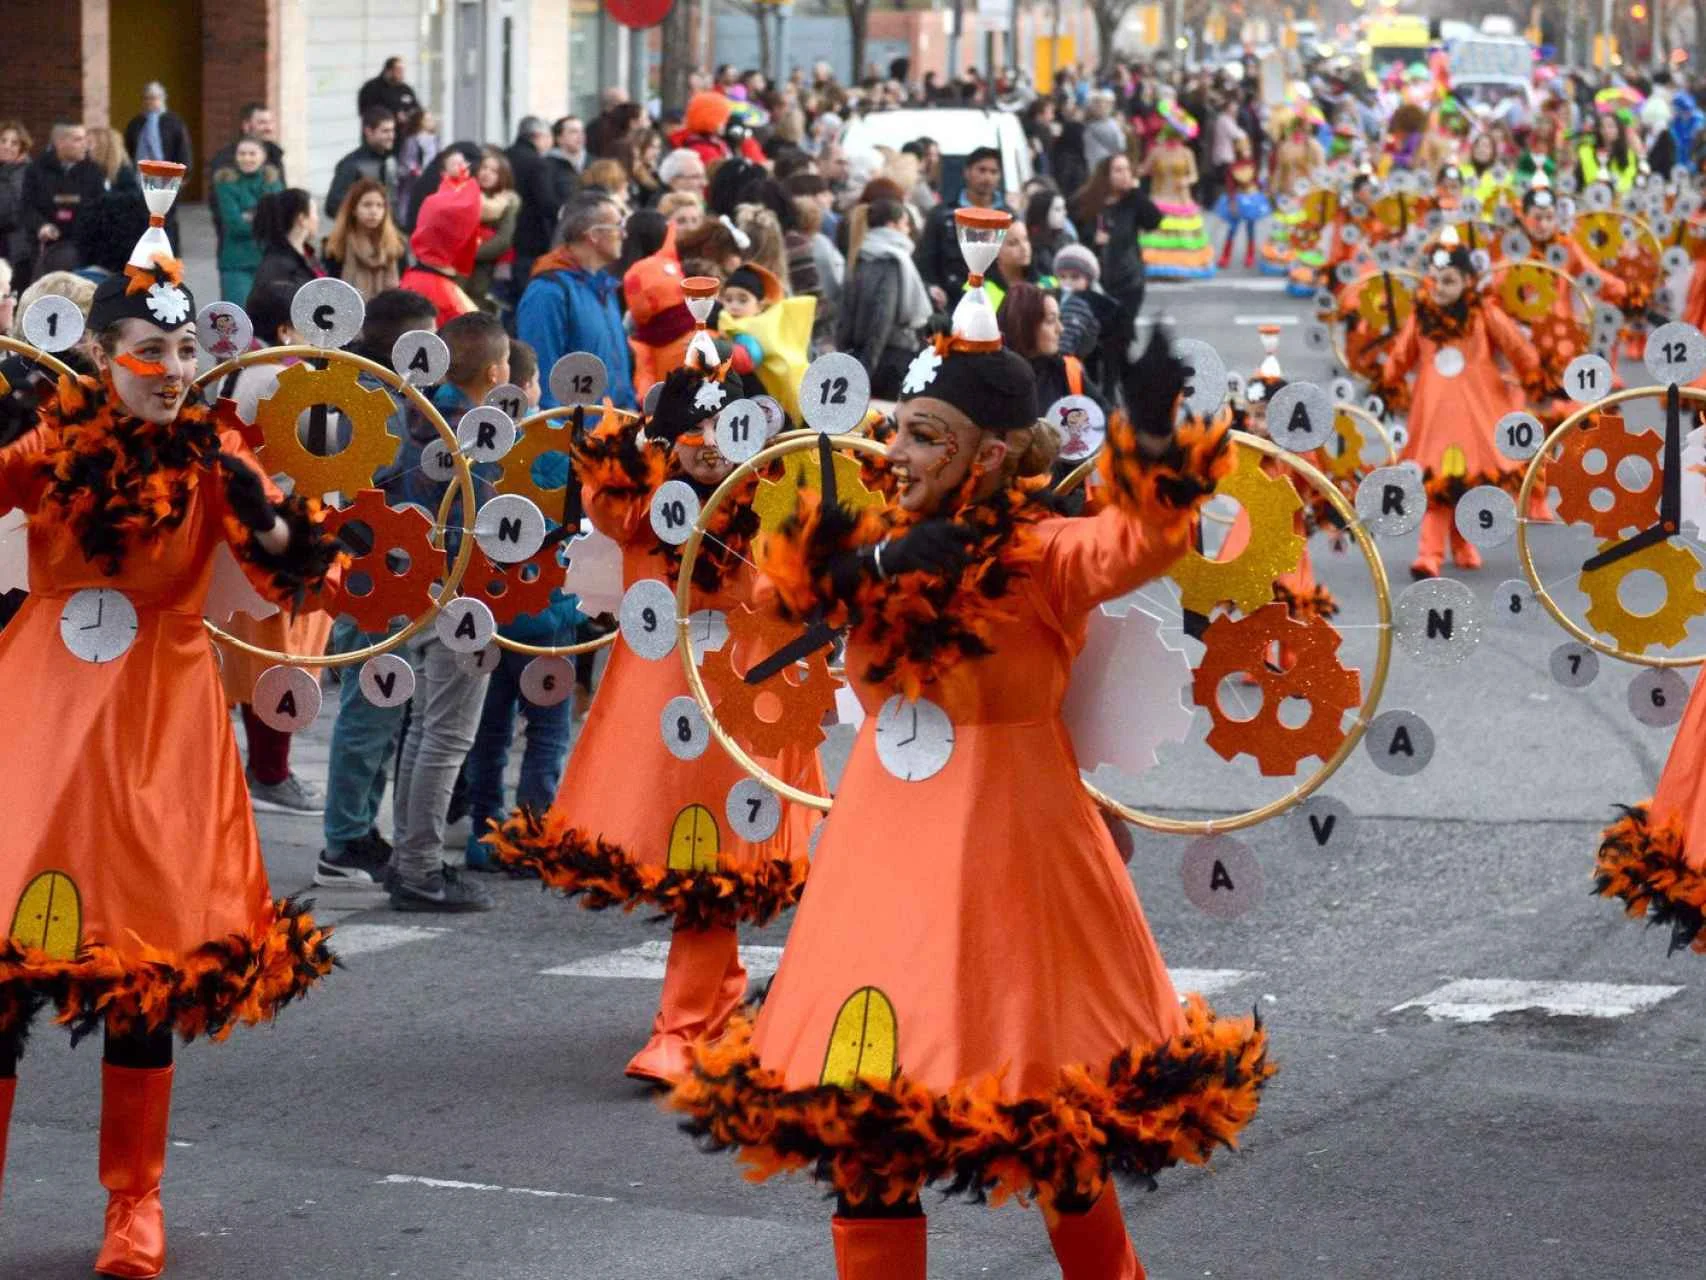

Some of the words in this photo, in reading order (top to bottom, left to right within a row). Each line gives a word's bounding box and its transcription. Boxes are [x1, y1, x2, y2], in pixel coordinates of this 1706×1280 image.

[47, 313, 58, 336] 1
[313, 305, 335, 330] C
[409, 347, 429, 373] A
[1663, 343, 1686, 363] 12
[572, 376, 593, 394] 12
[821, 377, 848, 404] 12
[1578, 369, 1595, 389] 11
[499, 398, 520, 418] 11
[1288, 402, 1312, 433] A
[477, 422, 496, 449] R
[730, 415, 749, 442] 11
[1507, 423, 1532, 447] 10
[436, 452, 454, 468] 10
[1382, 485, 1404, 516] R
[661, 501, 685, 528] 10
[1479, 510, 1493, 529] 9
[499, 517, 521, 543] N
[1510, 594, 1521, 613] 8
[455, 612, 476, 640] A
[643, 608, 656, 632] 9
[1427, 609, 1452, 638] N
[474, 650, 484, 667] 7
[1568, 655, 1581, 674] 7
[374, 672, 396, 698] V
[543, 675, 555, 691] 6
[276, 690, 296, 718] A
[1652, 688, 1665, 707] 6
[677, 716, 691, 742] 8
[1389, 726, 1413, 756] A
[747, 799, 761, 823] 7
[1309, 815, 1336, 845] V
[1210, 860, 1234, 891] A
